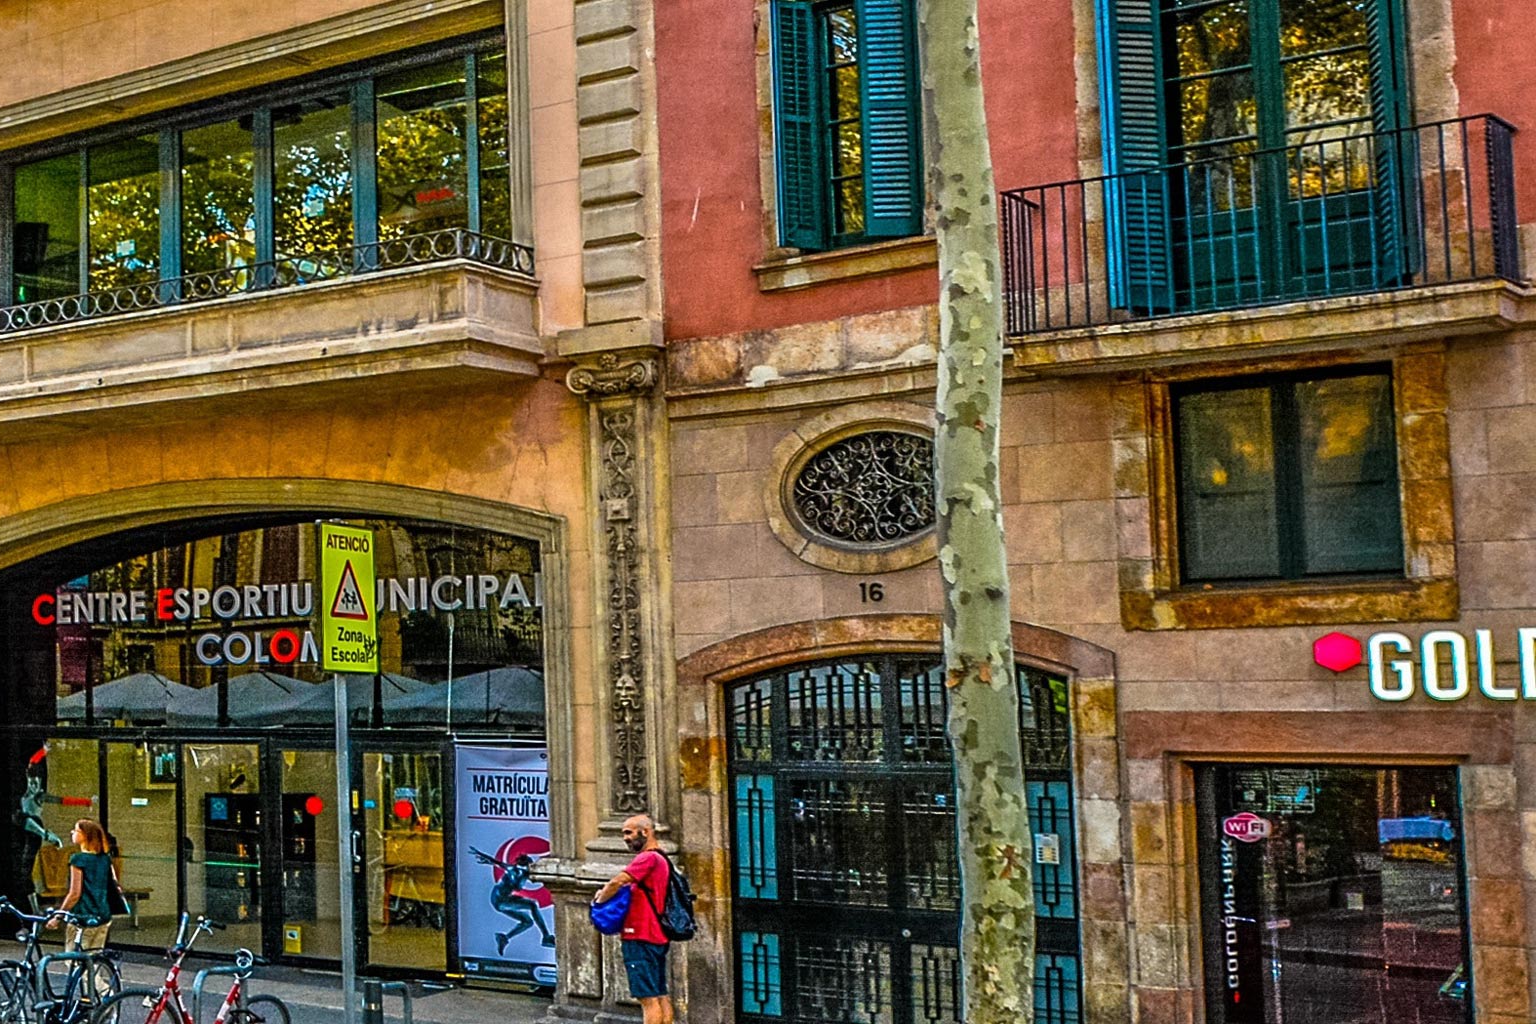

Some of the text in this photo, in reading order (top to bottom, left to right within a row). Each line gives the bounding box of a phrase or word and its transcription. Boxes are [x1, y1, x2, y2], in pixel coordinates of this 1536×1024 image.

[326, 533, 370, 554] ATENCIÓ
[859, 582, 884, 603] 16
[31, 590, 146, 626] CENTRE
[157, 582, 313, 621] ESPORTIU
[337, 626, 363, 644] Zona
[479, 796, 548, 818] GRATUÏTA
